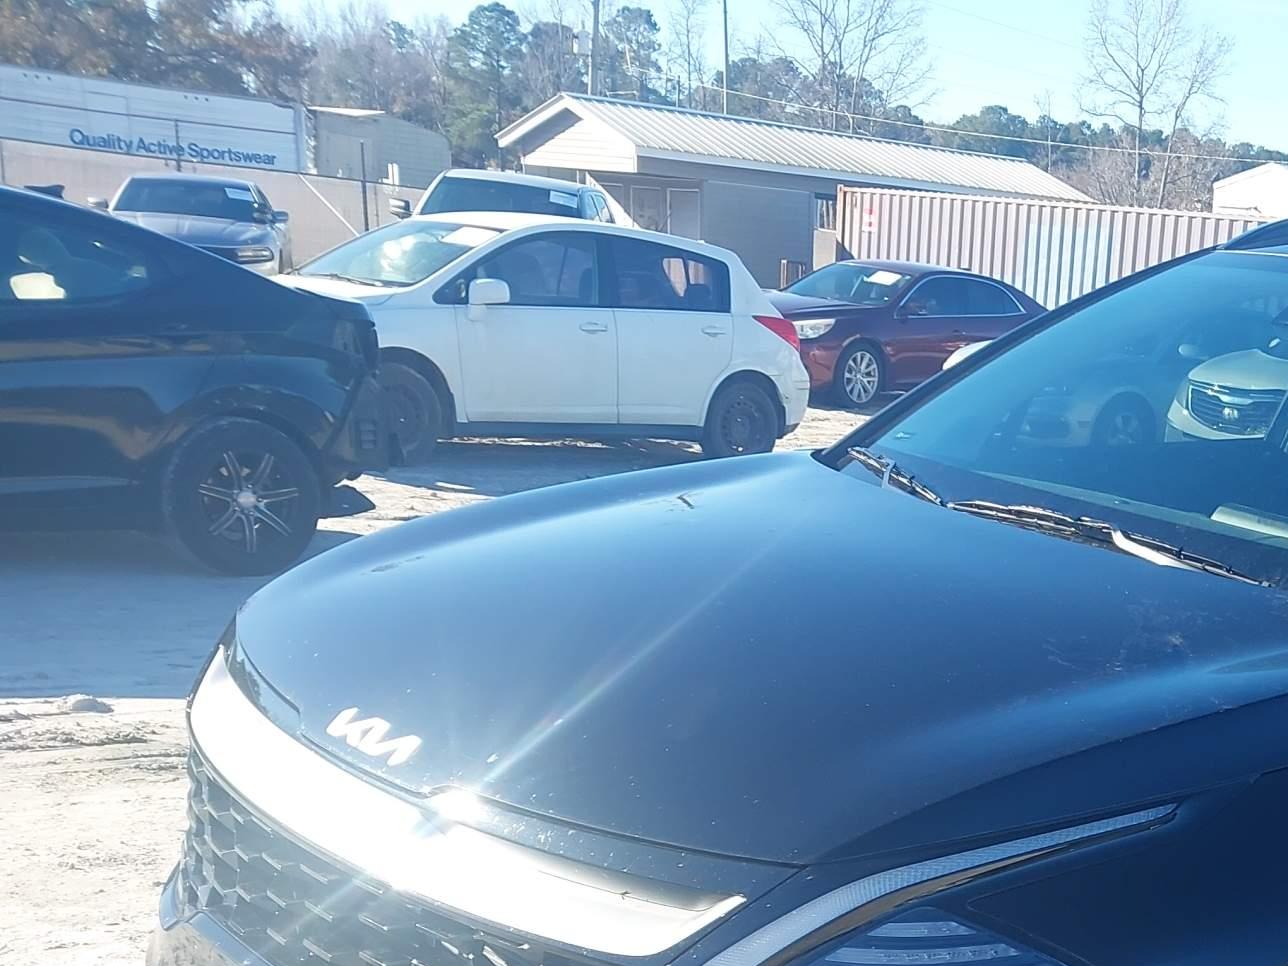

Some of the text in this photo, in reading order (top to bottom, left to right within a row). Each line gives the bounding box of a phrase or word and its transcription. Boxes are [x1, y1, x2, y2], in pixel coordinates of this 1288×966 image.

[69, 128, 277, 166] Quality Active Sportswear
[326, 707, 422, 766] KIA
